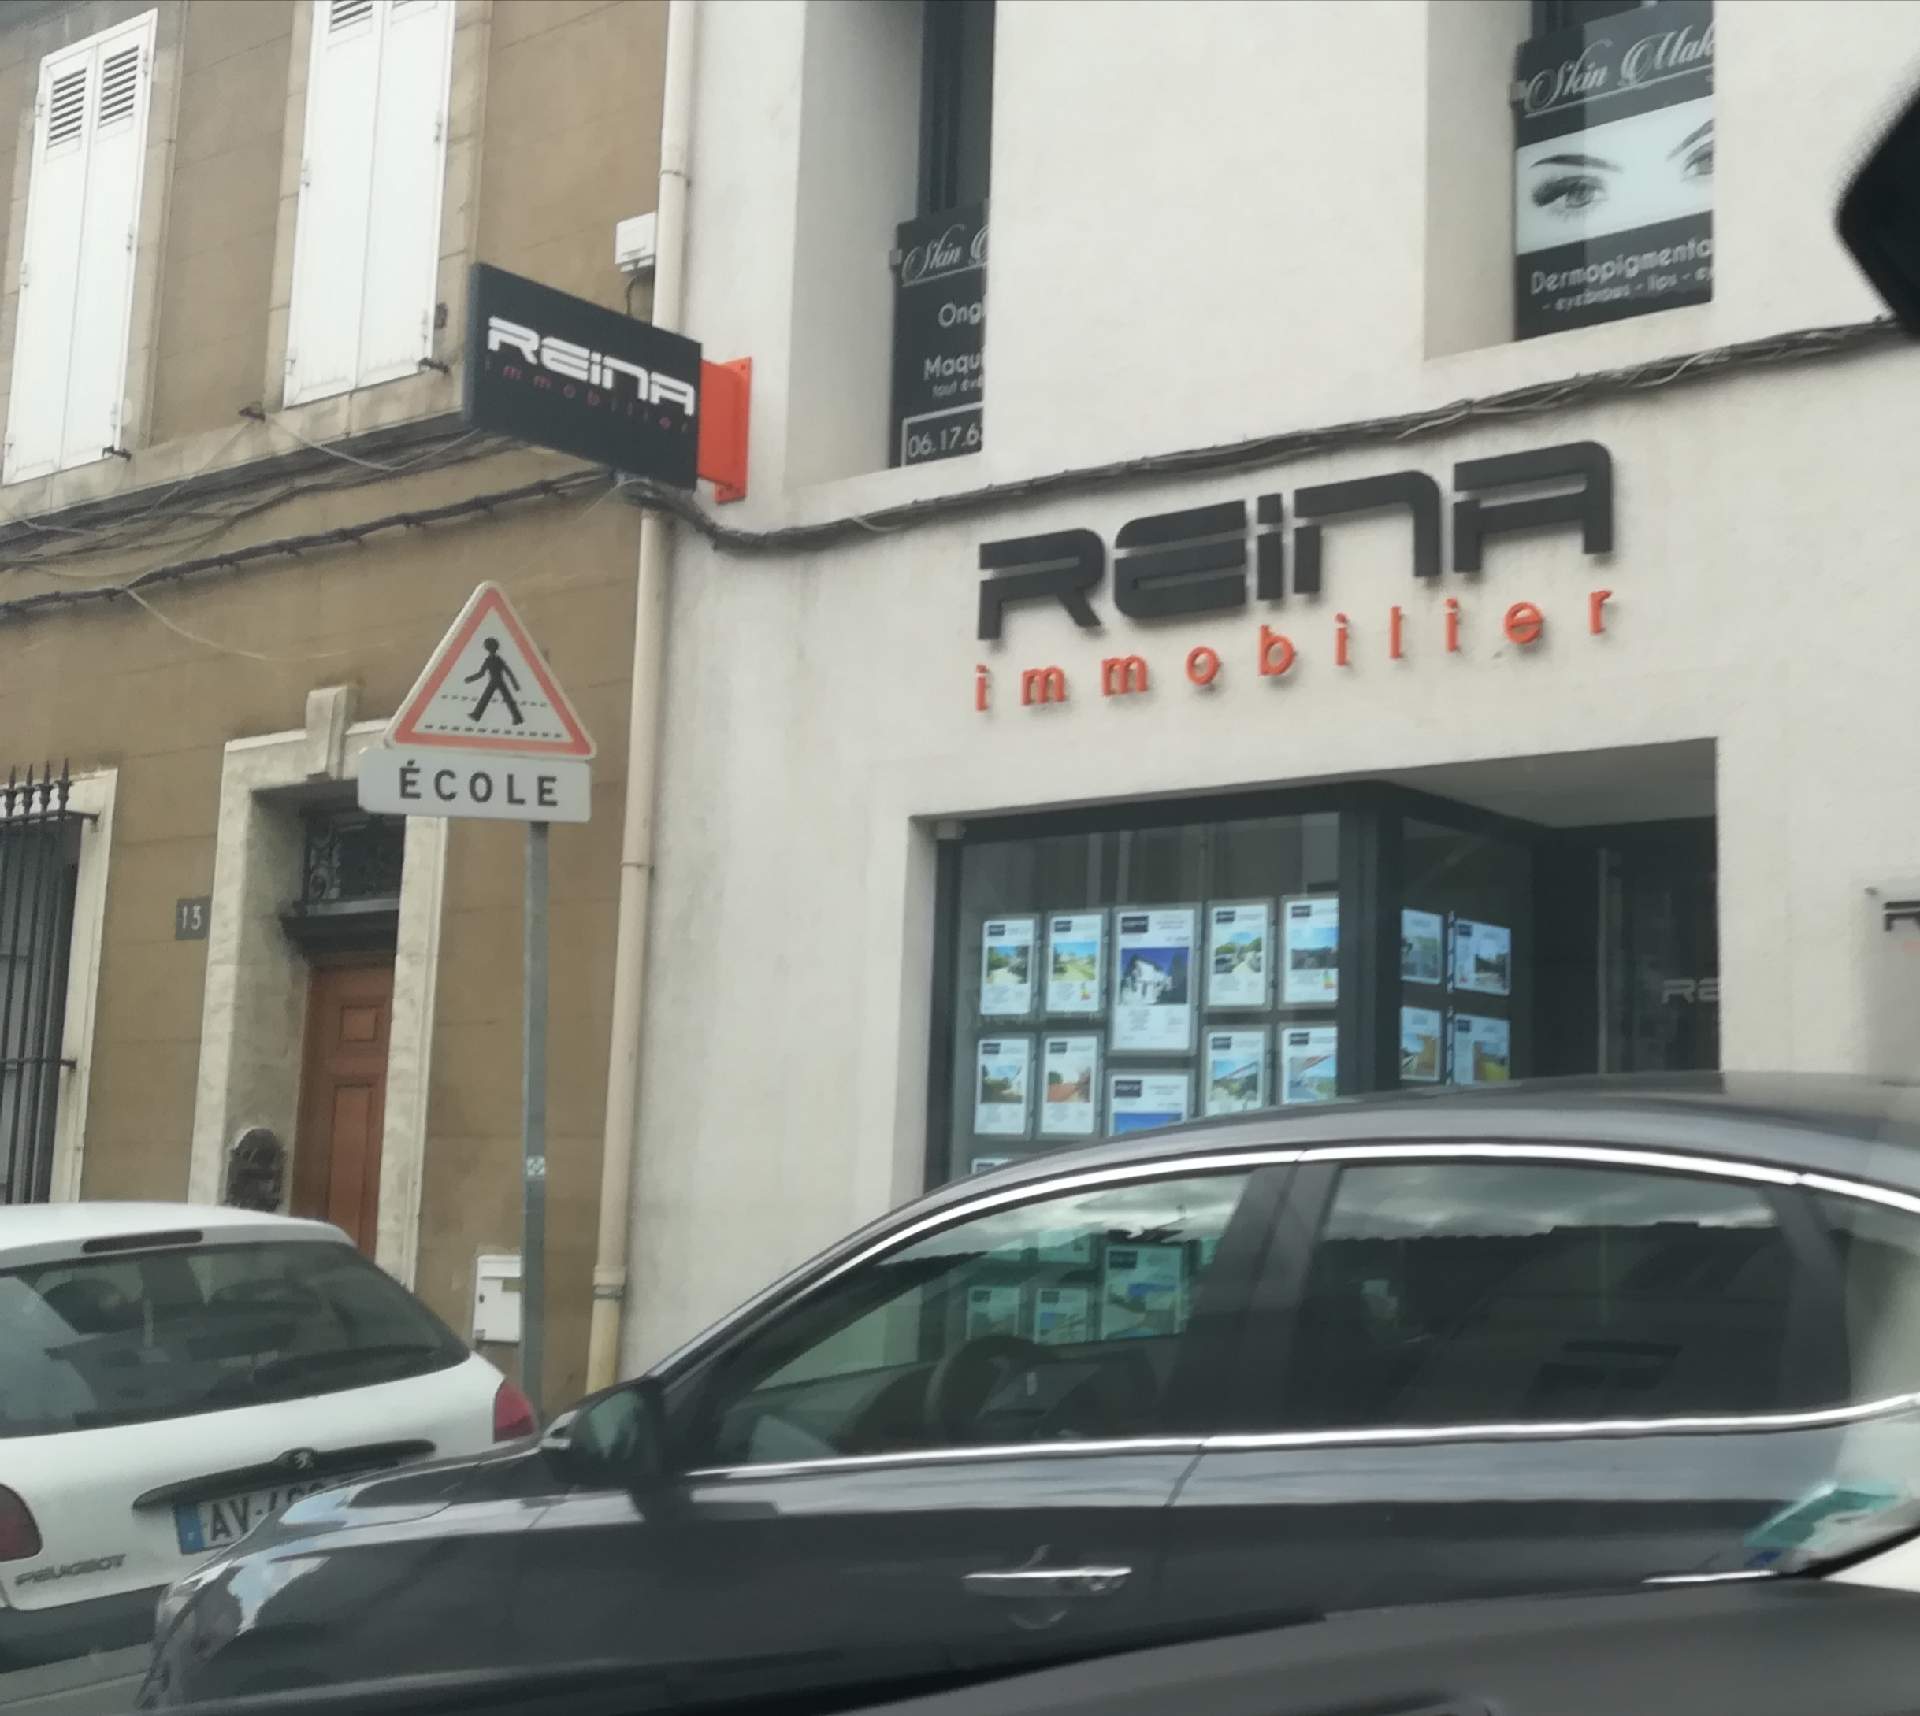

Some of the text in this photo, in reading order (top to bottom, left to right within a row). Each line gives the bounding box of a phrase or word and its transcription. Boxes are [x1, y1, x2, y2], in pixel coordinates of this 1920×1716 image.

[484, 353, 690, 434] immobilier
[975, 588, 1612, 712] immobilier
[399, 759, 559, 807] ÉCOLE
